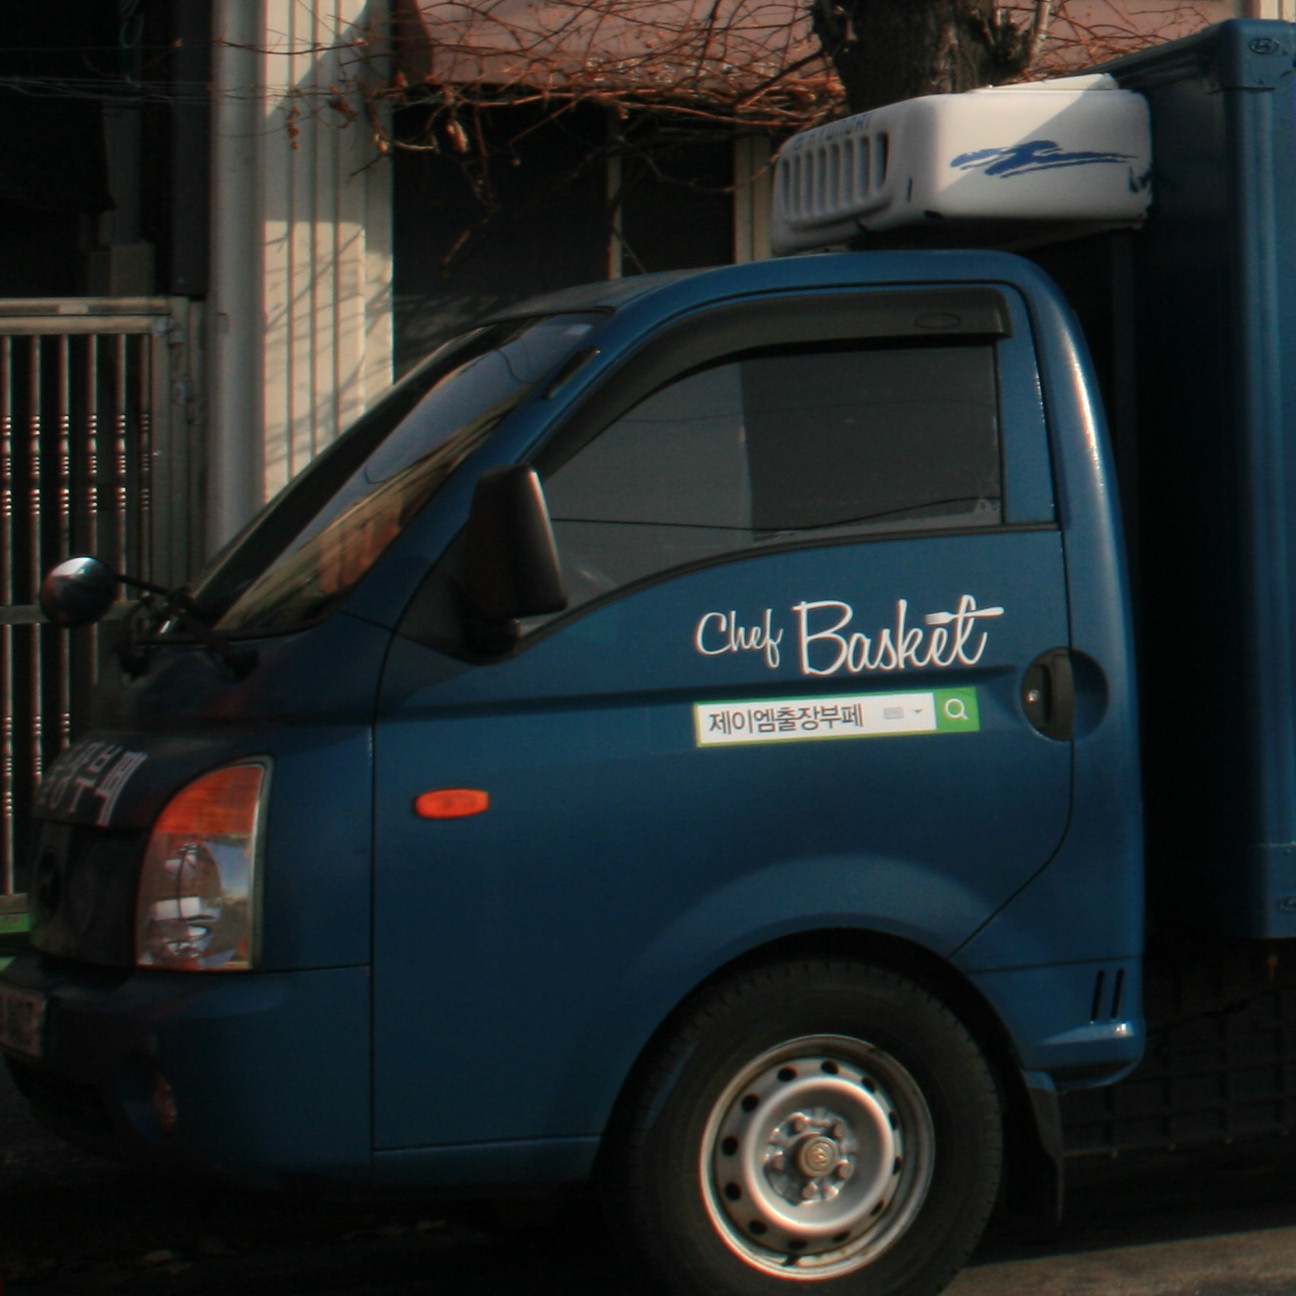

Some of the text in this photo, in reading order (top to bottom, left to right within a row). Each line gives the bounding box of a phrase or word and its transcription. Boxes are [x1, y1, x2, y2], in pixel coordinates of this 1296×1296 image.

[695, 594, 1004, 675] Chef Basket
[709, 704, 864, 735] 제이엠출장부페
